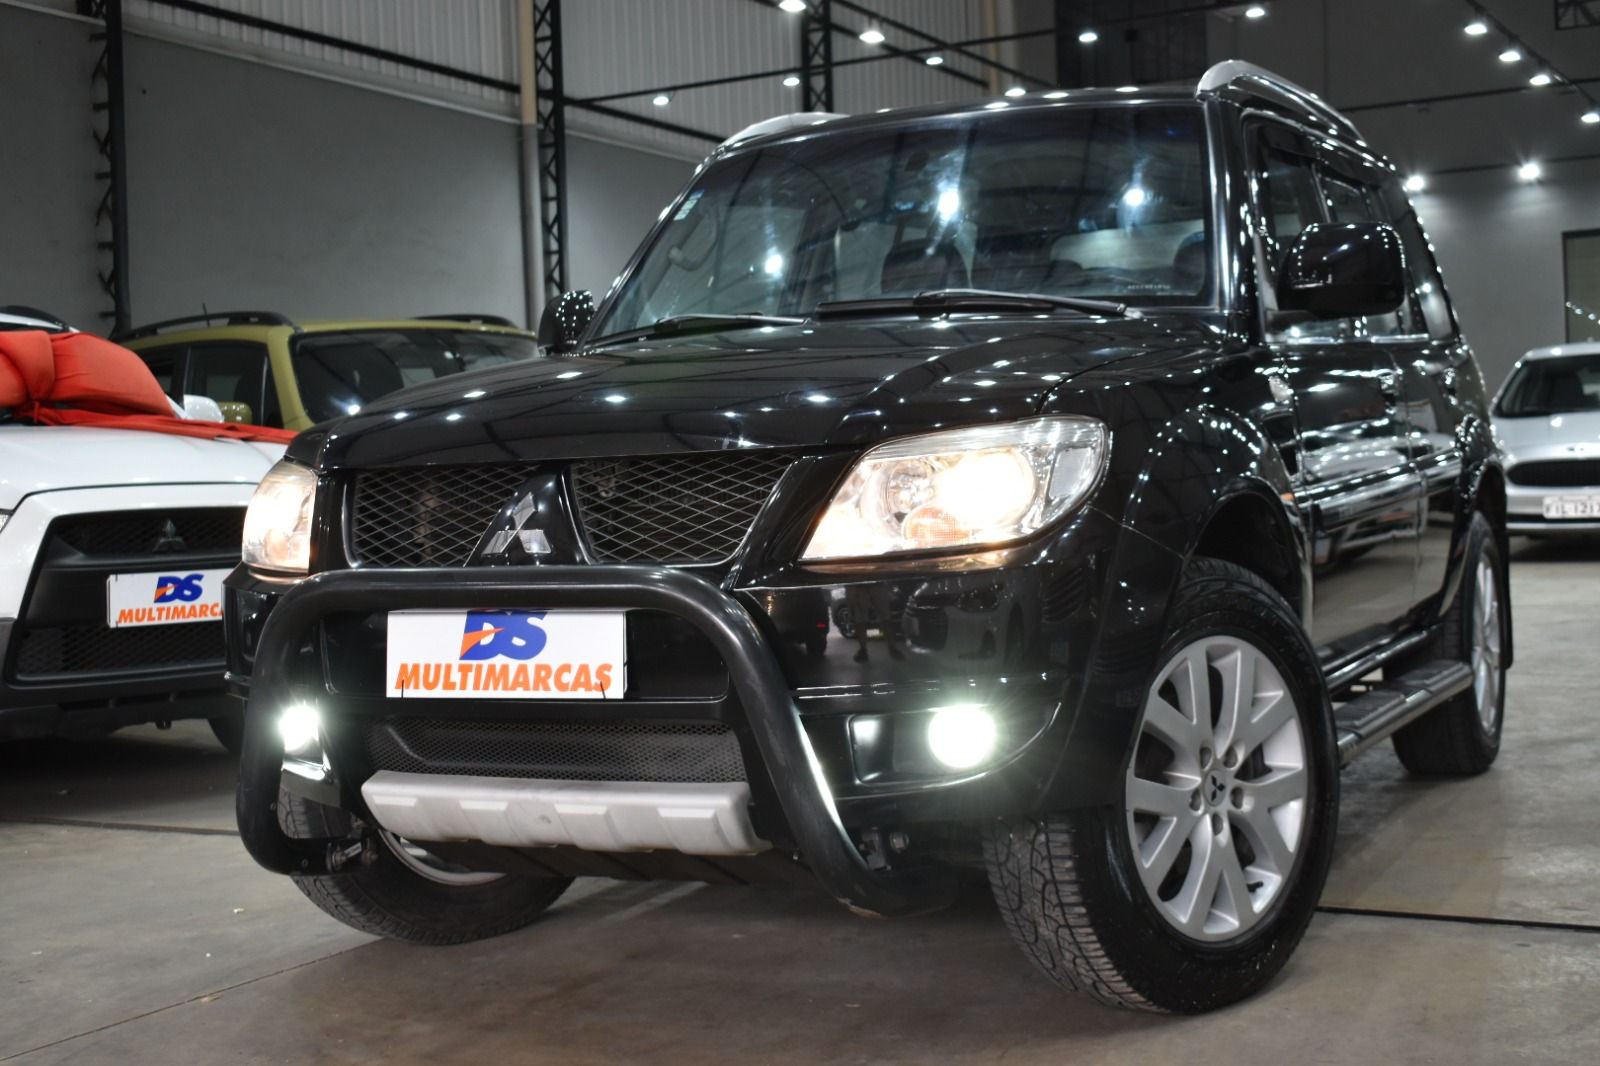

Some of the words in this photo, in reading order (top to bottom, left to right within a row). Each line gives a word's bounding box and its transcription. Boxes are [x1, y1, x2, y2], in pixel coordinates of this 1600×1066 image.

[154, 573, 204, 603] DS
[459, 611, 548, 661] DS
[395, 663, 613, 692] MULTIMARCAS
